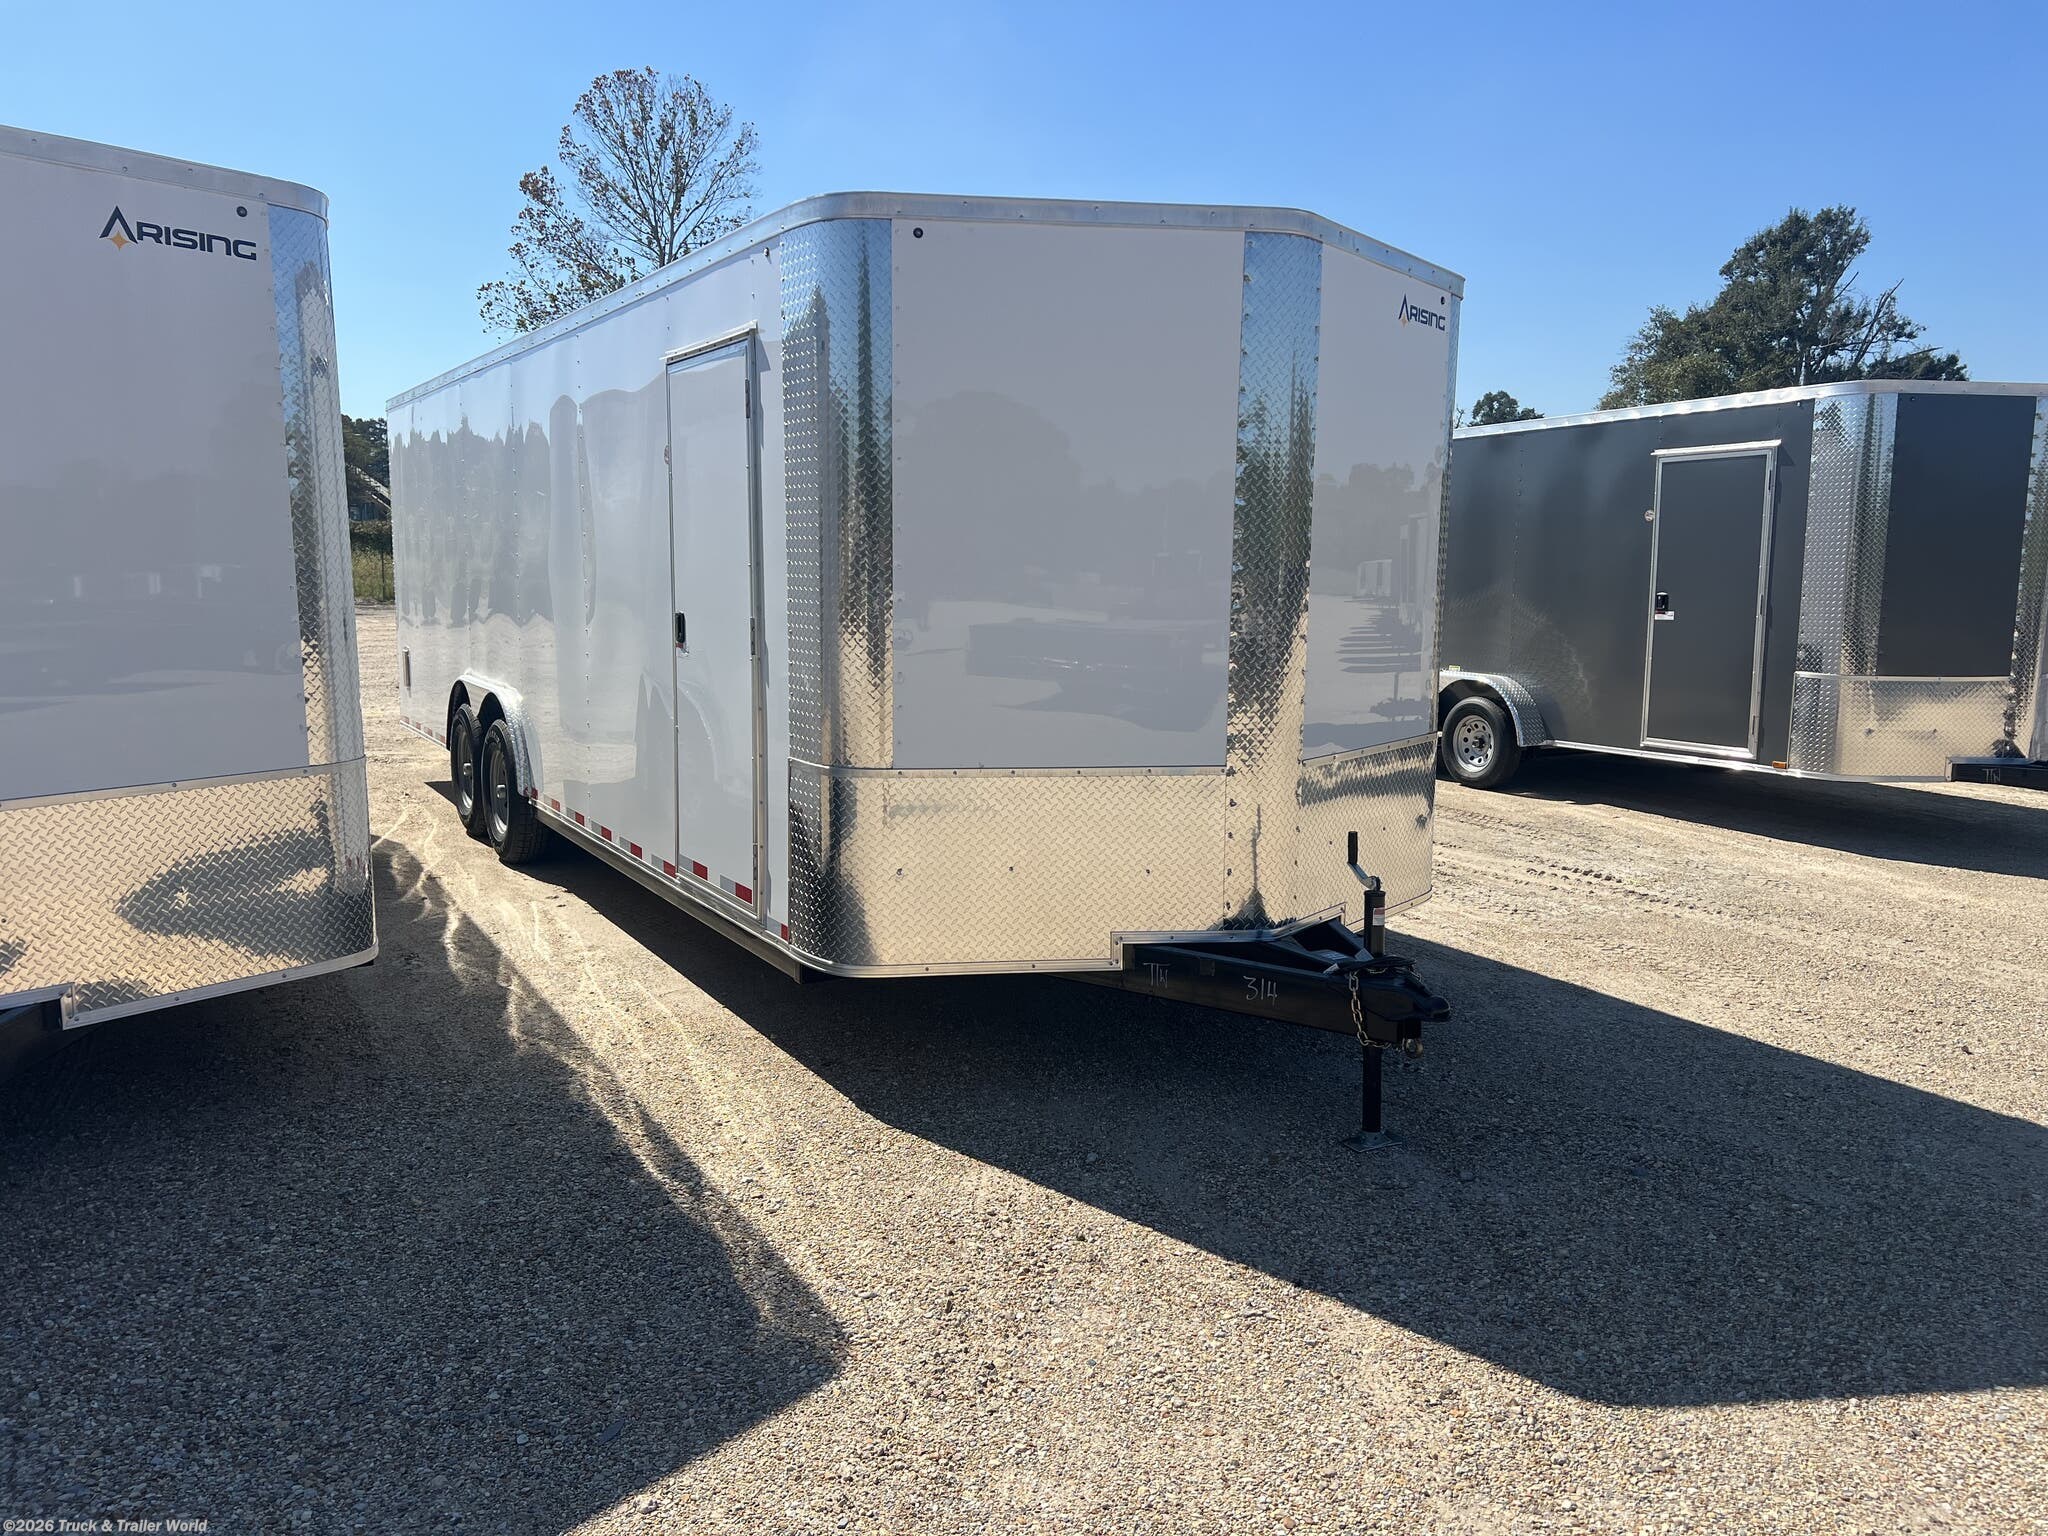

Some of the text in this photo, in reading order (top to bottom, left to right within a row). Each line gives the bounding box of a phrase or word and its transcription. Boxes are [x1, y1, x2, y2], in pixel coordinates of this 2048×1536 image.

[99, 205, 257, 261] ARISING
[1398, 293, 1446, 331] ARISING
[1242, 975, 1278, 1006] 314
